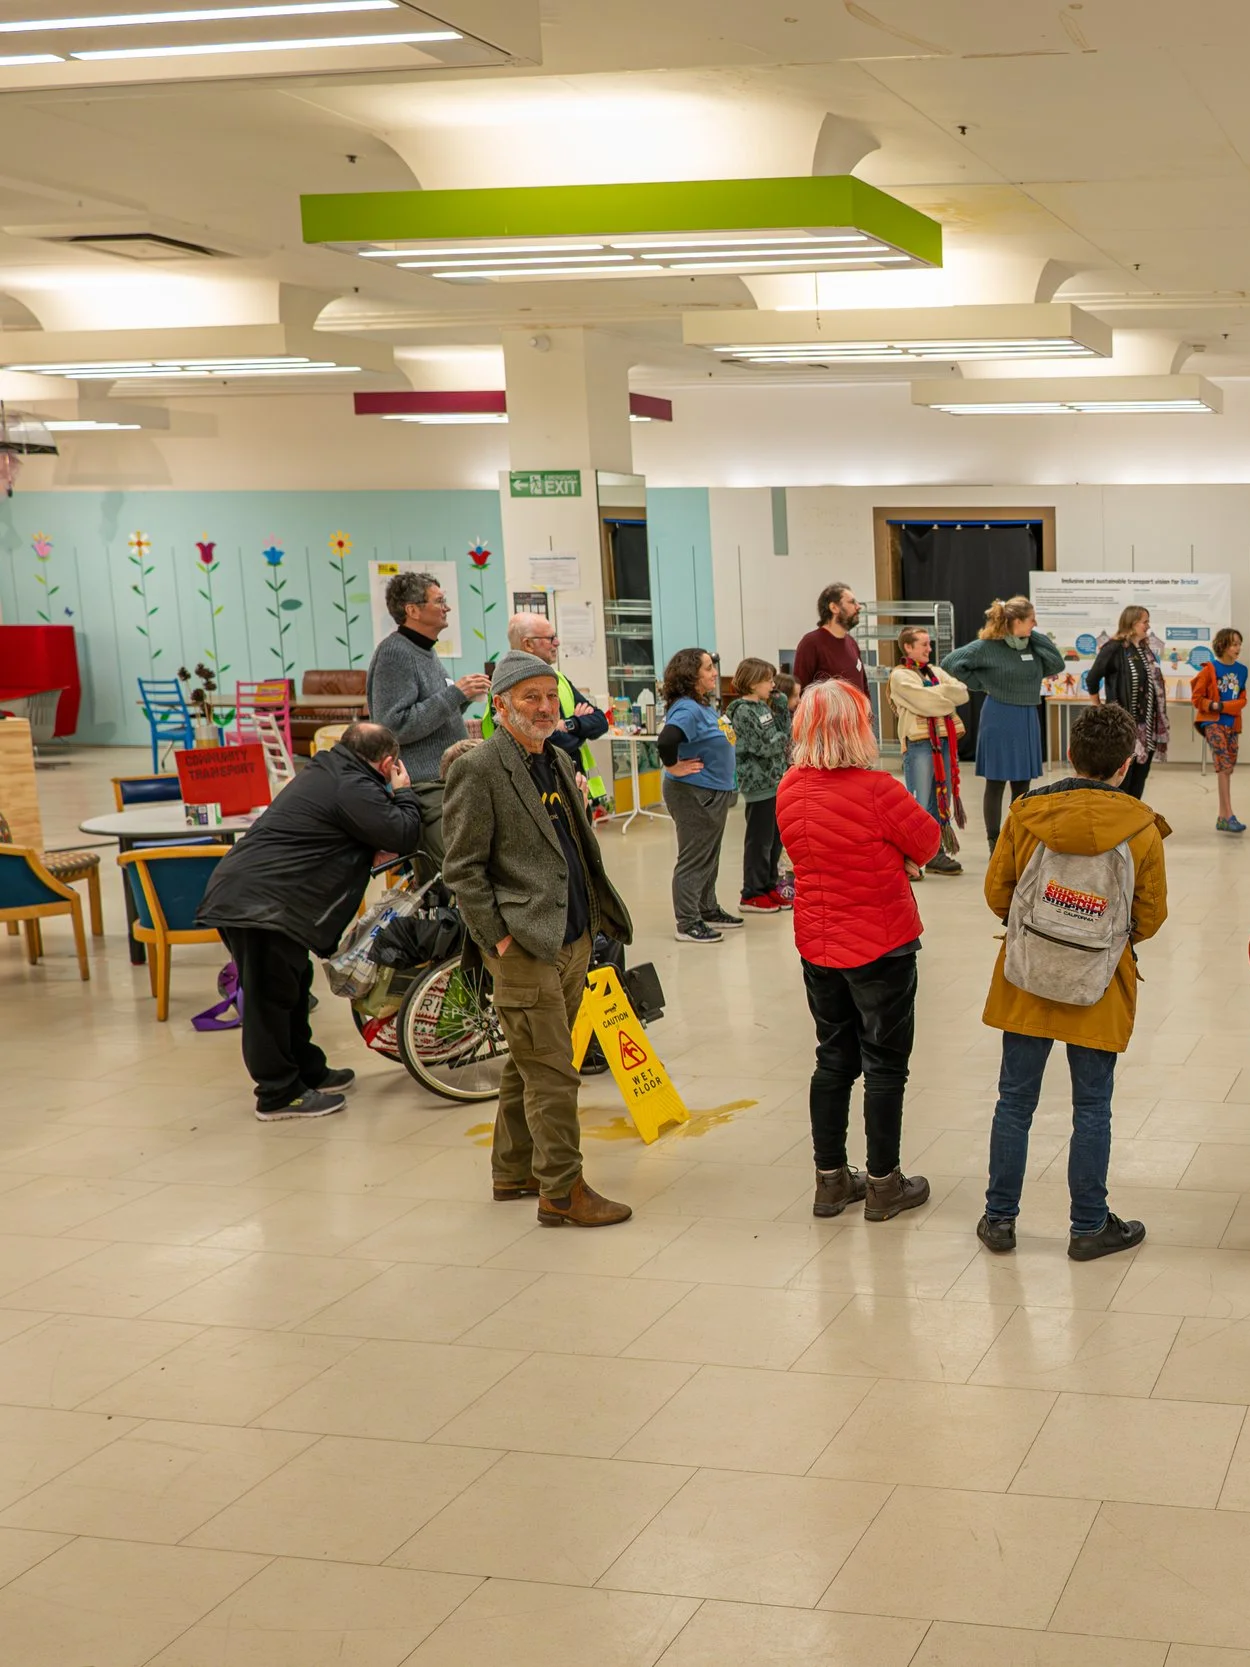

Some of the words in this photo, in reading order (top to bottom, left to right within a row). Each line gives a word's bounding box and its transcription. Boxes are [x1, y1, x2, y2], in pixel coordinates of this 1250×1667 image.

[544, 480, 578, 495] EXIT
[185, 750, 248, 767] COMMUNITY
[188, 761, 256, 781] TRANSPORT
[602, 1011, 629, 1029] CAUTION
[632, 1068, 654, 1085] WET
[633, 1076, 662, 1098] FLOOR
